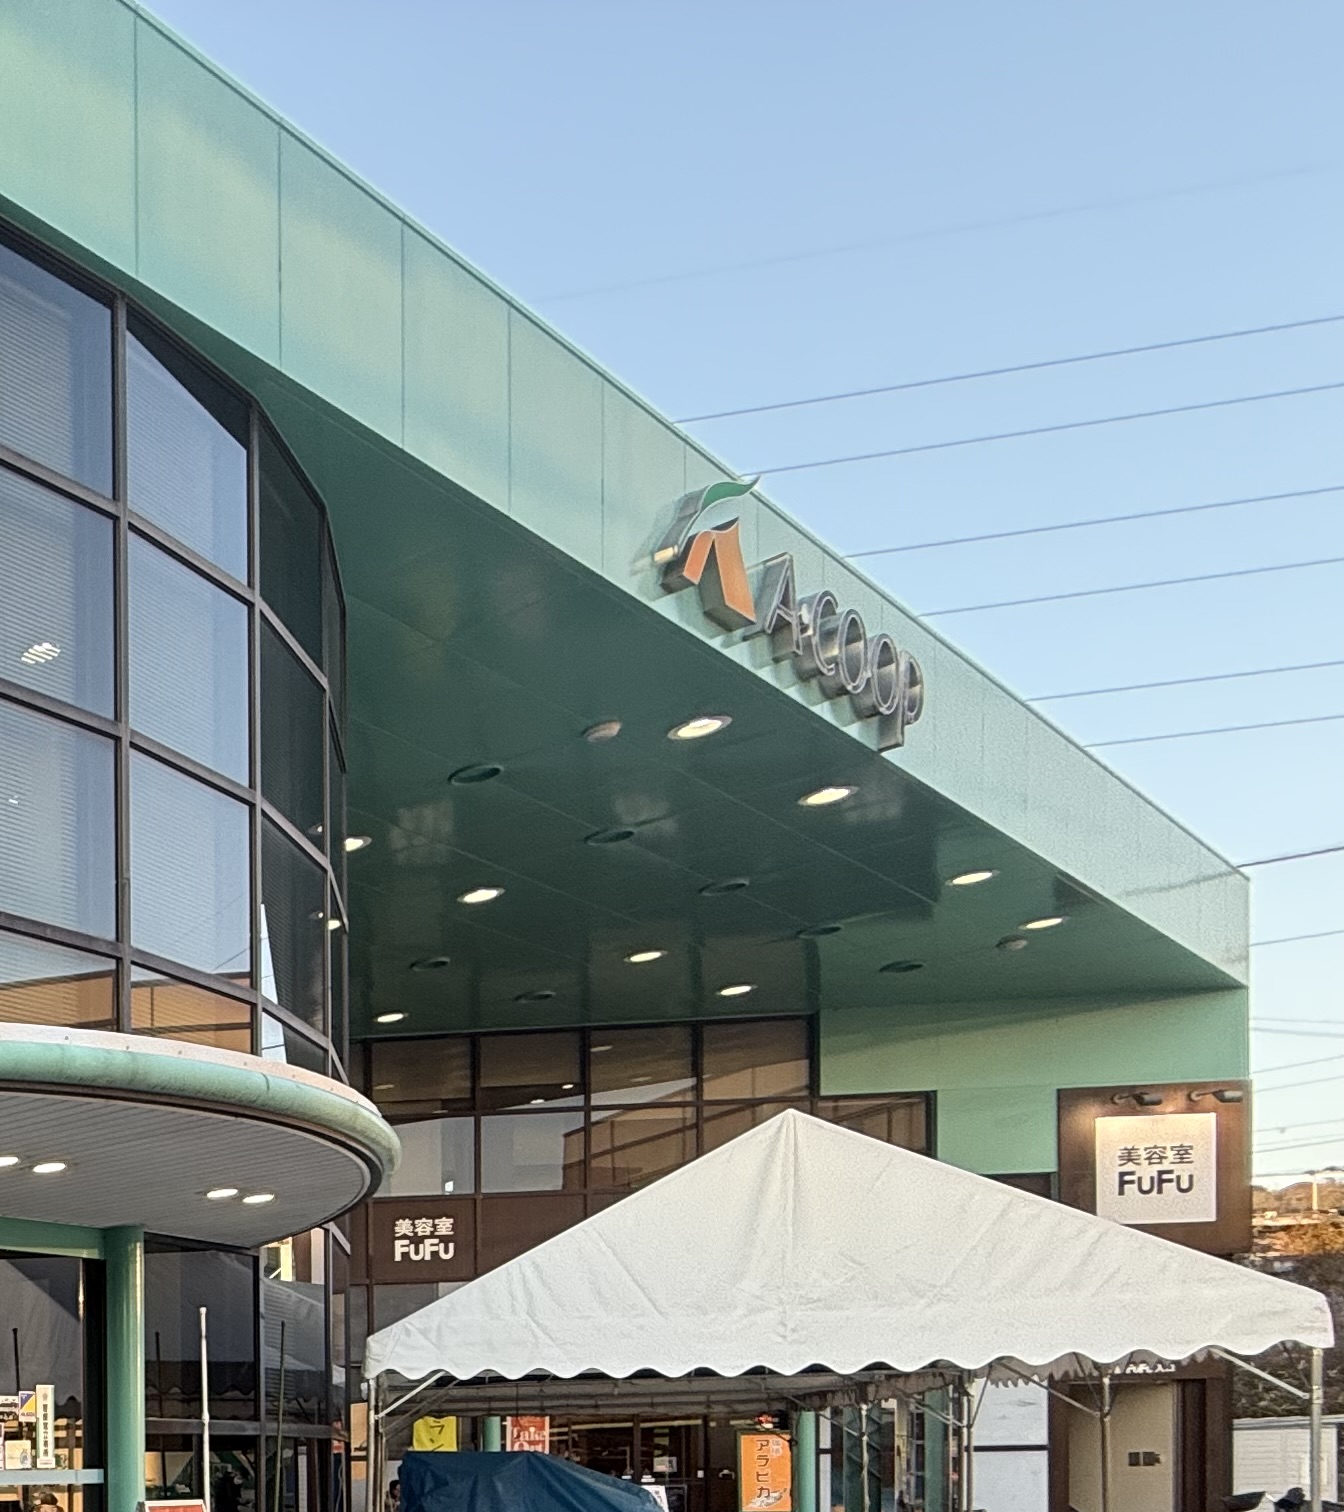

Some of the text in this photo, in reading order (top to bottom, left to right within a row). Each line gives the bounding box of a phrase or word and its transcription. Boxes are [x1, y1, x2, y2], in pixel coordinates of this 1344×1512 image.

[1118, 1144, 1194, 1167] 美容室
[394, 1217, 454, 1237] 美容室
